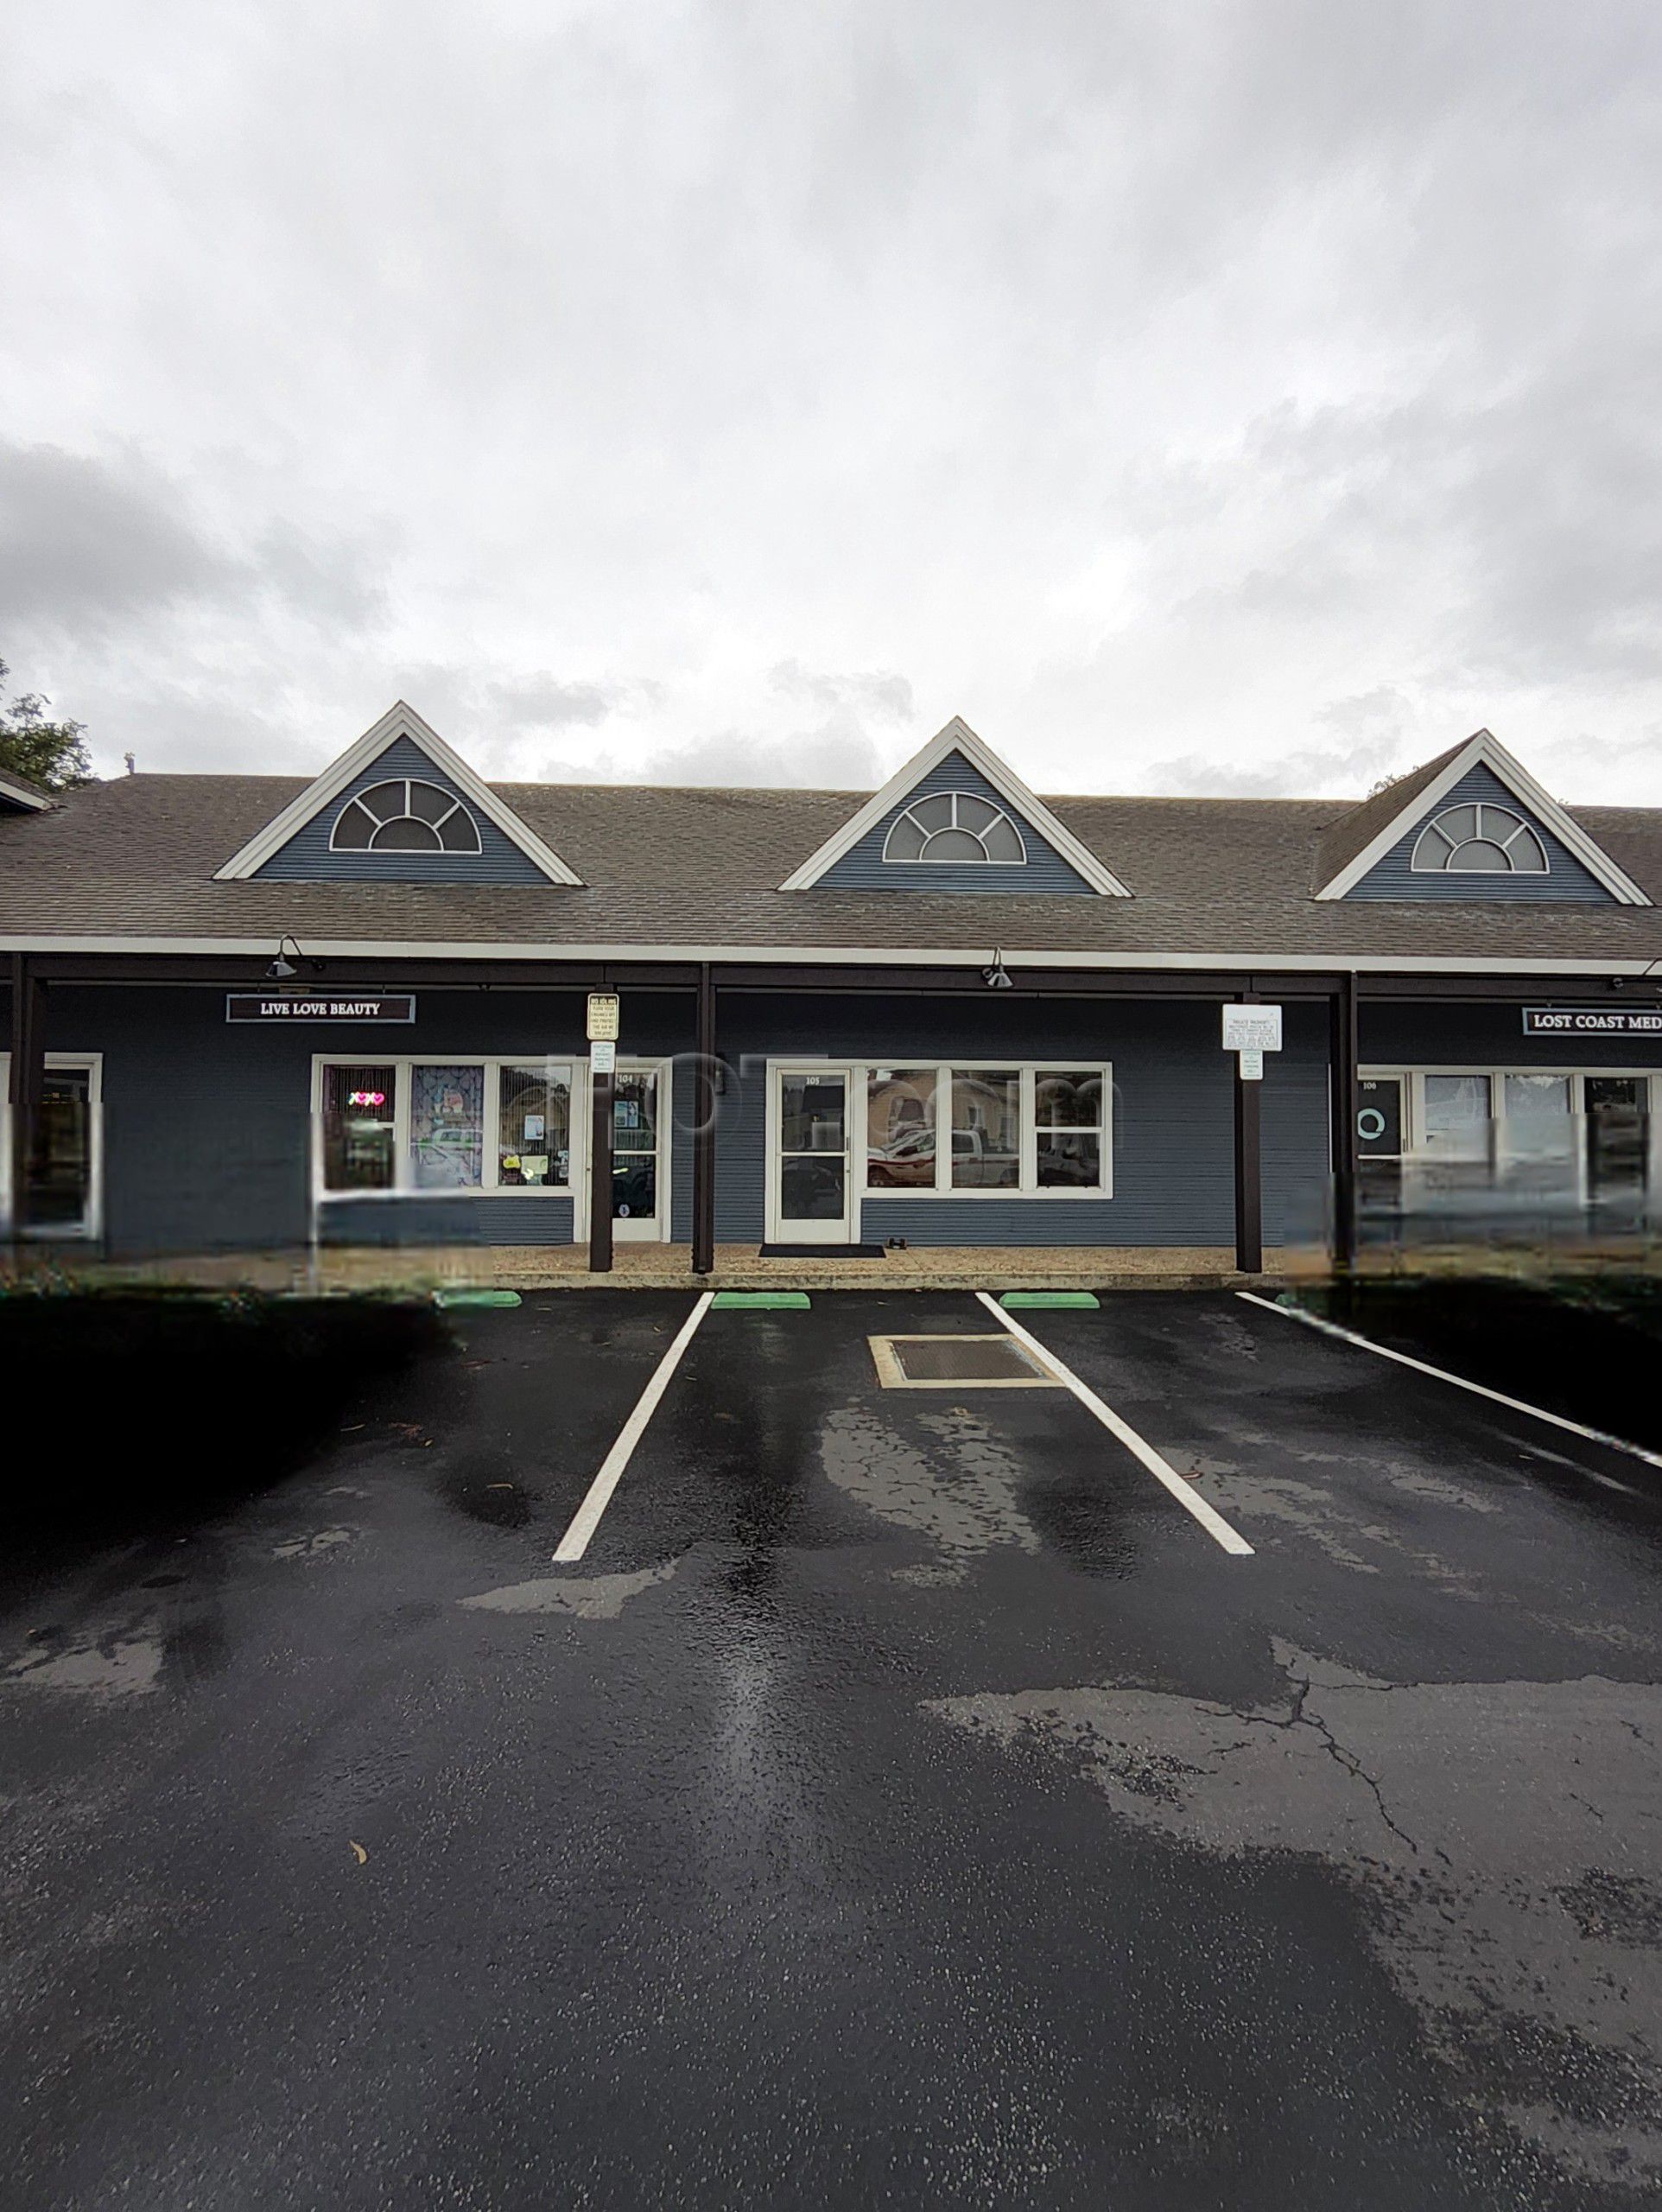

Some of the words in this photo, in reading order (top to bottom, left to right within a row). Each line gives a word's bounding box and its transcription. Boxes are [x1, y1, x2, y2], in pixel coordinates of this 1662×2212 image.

[260, 1002, 289, 1015] LIVE
[293, 1002, 327, 1015] LOVE
[330, 1002, 381, 1016] BEAUTY
[1533, 1014, 1572, 1028] LOST
[1576, 1014, 1625, 1029] COAST
[1628, 1015, 1662, 1030] MED
[618, 1074, 633, 1084] 104
[806, 1077, 820, 1085] 105
